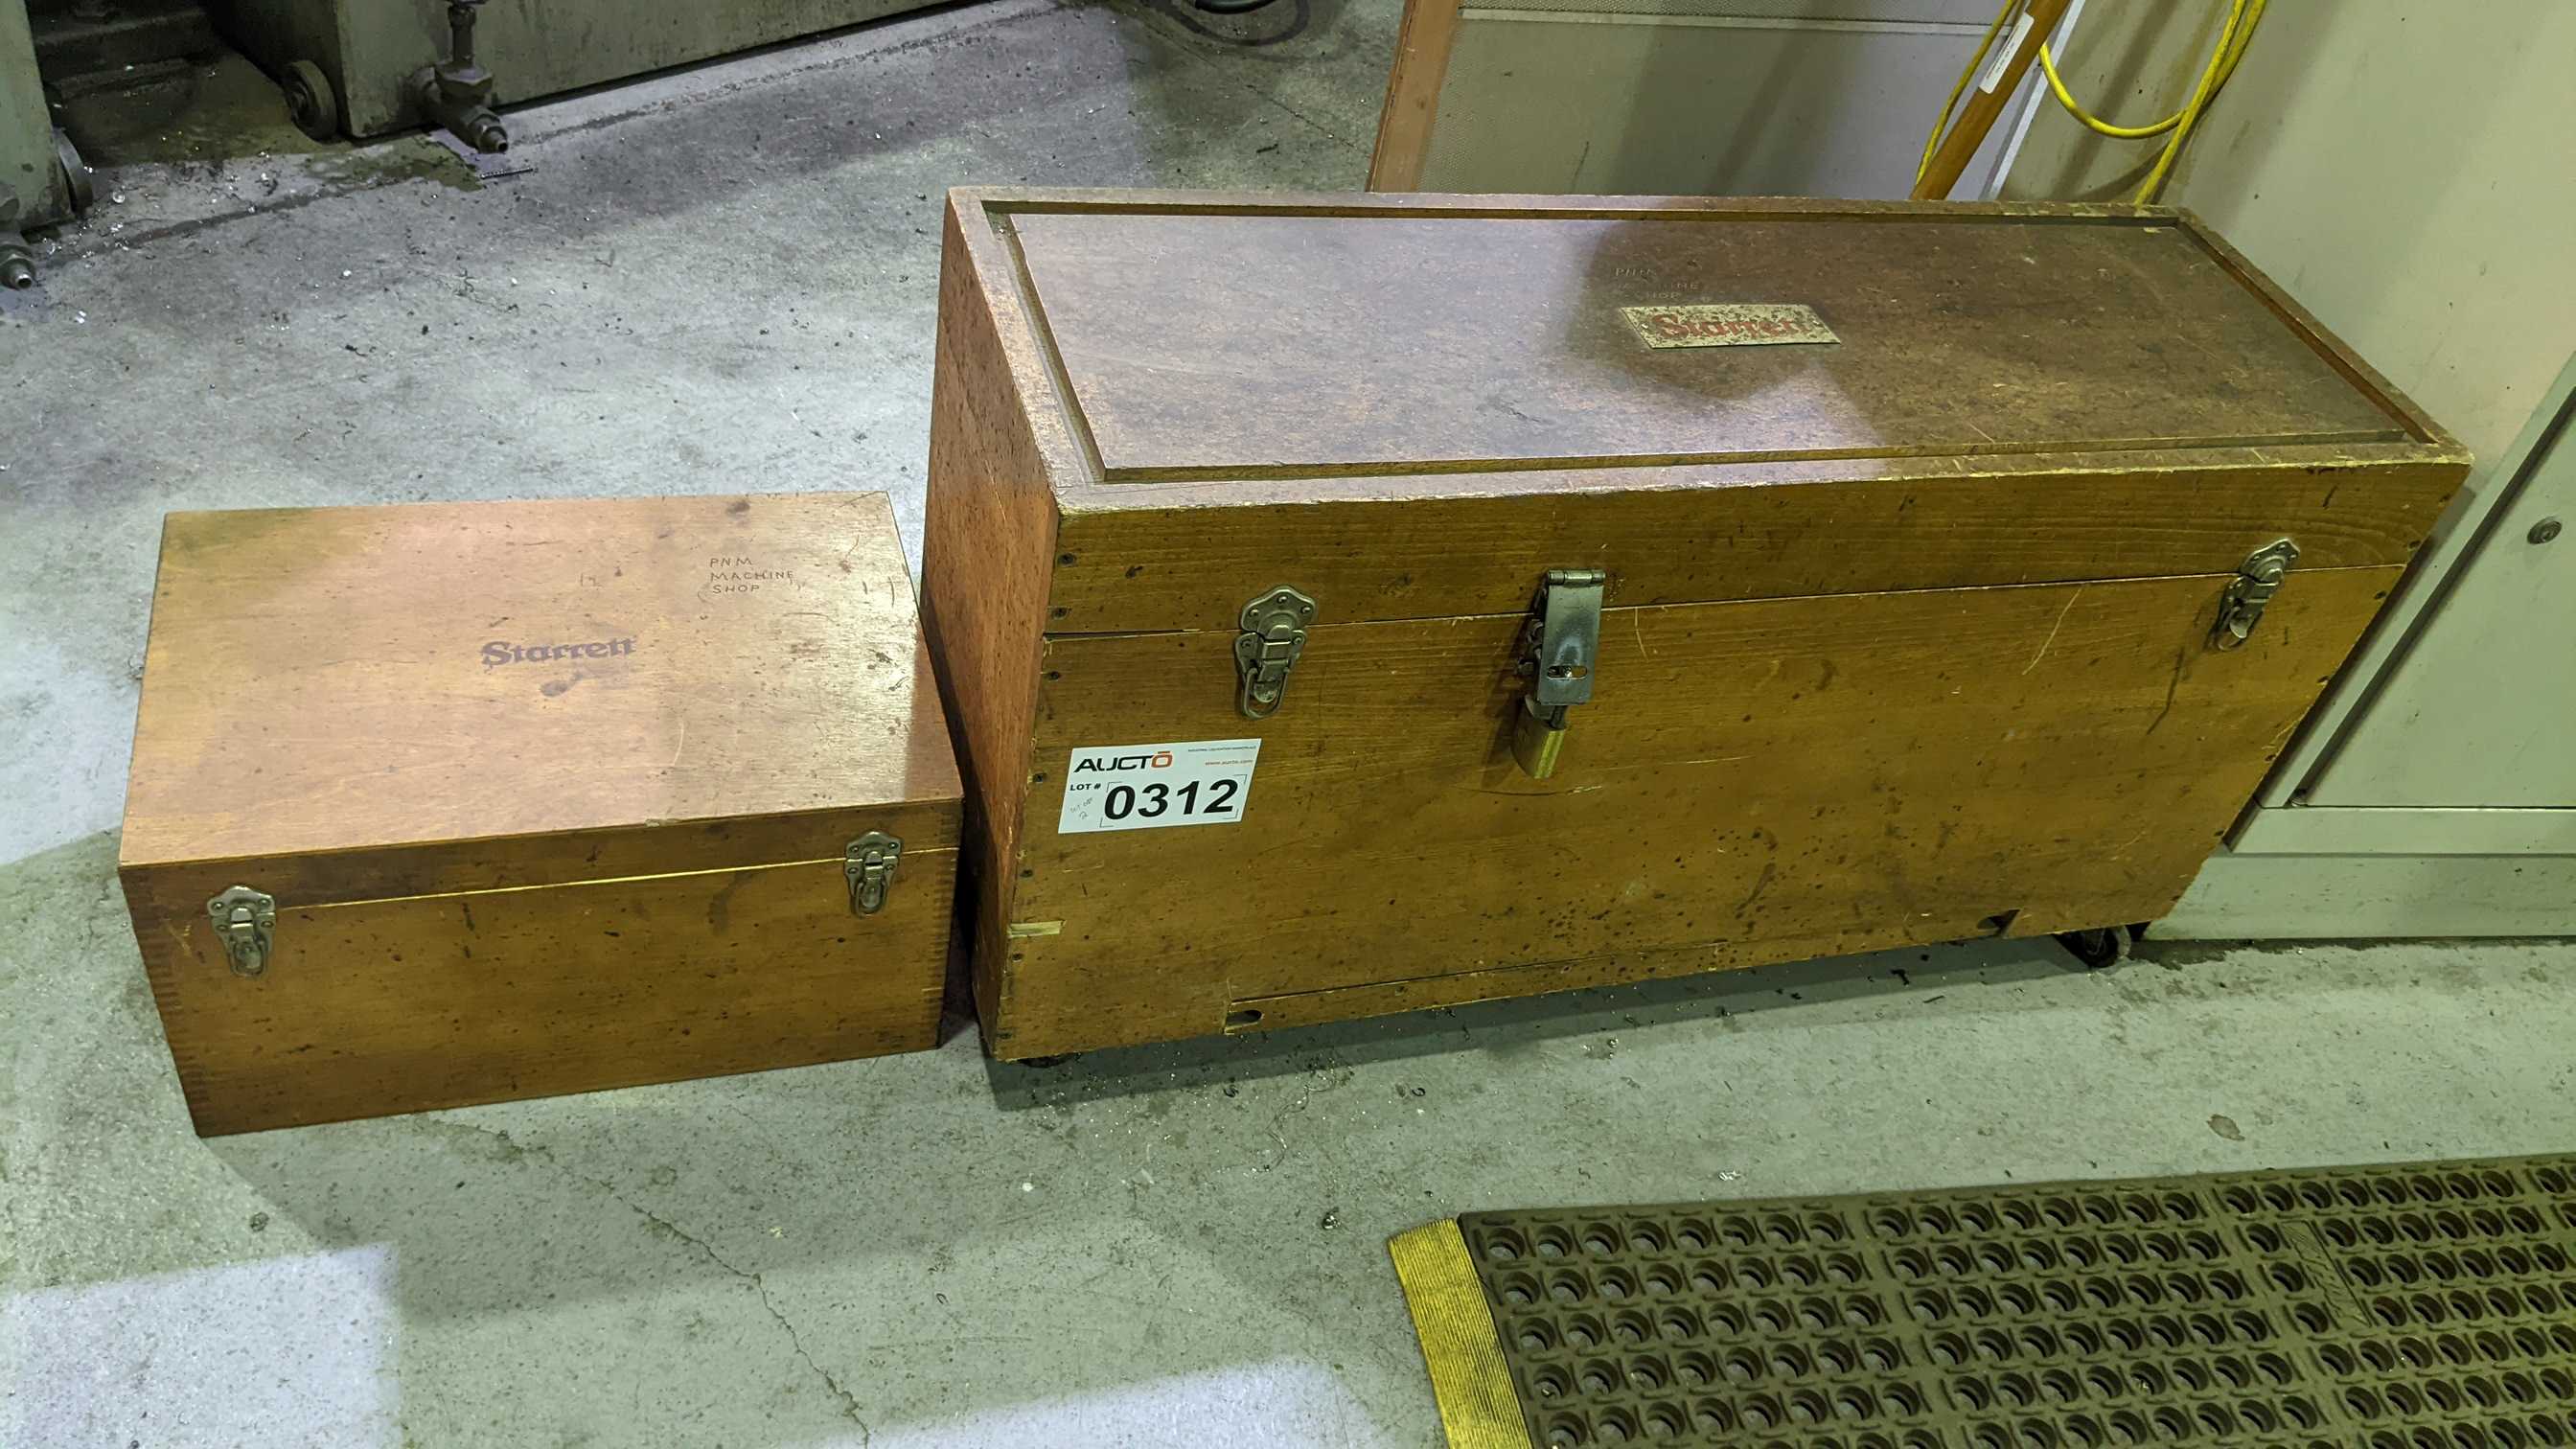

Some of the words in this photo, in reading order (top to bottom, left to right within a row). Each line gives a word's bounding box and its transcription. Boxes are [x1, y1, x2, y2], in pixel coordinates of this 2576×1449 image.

[710, 558, 752, 567] PNM
[710, 570, 794, 581] MACHINE
[712, 584, 760, 594] SHOP
[479, 636, 638, 667] Starrett
[1105, 779, 1238, 819] 0312
